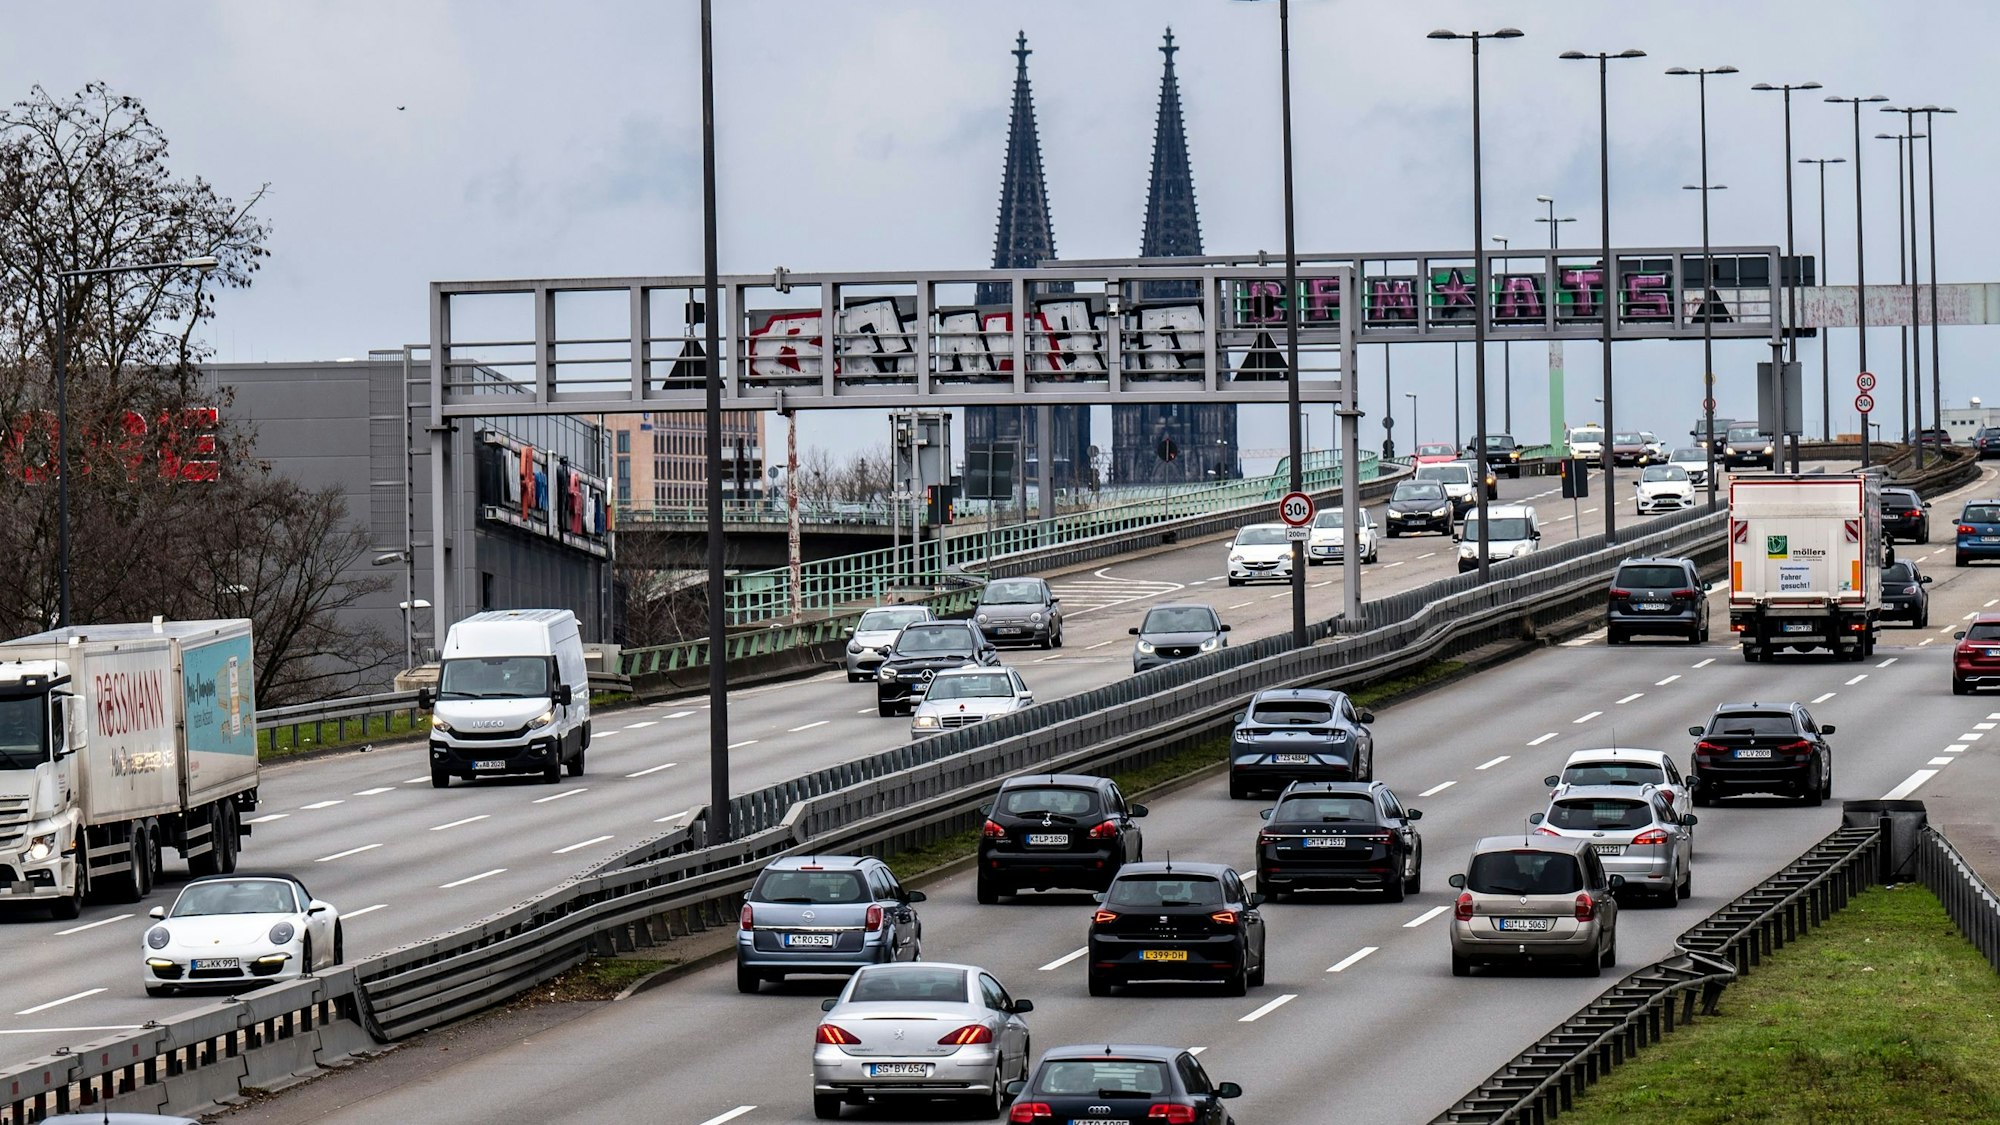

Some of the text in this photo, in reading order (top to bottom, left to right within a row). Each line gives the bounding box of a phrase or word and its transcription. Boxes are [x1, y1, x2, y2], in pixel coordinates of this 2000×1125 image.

[1860, 377, 1872, 386] 80
[1285, 502, 1306, 516] 30t
[96, 669, 164, 738] ROSSMANN
[472, 720, 504, 728] IVECO
